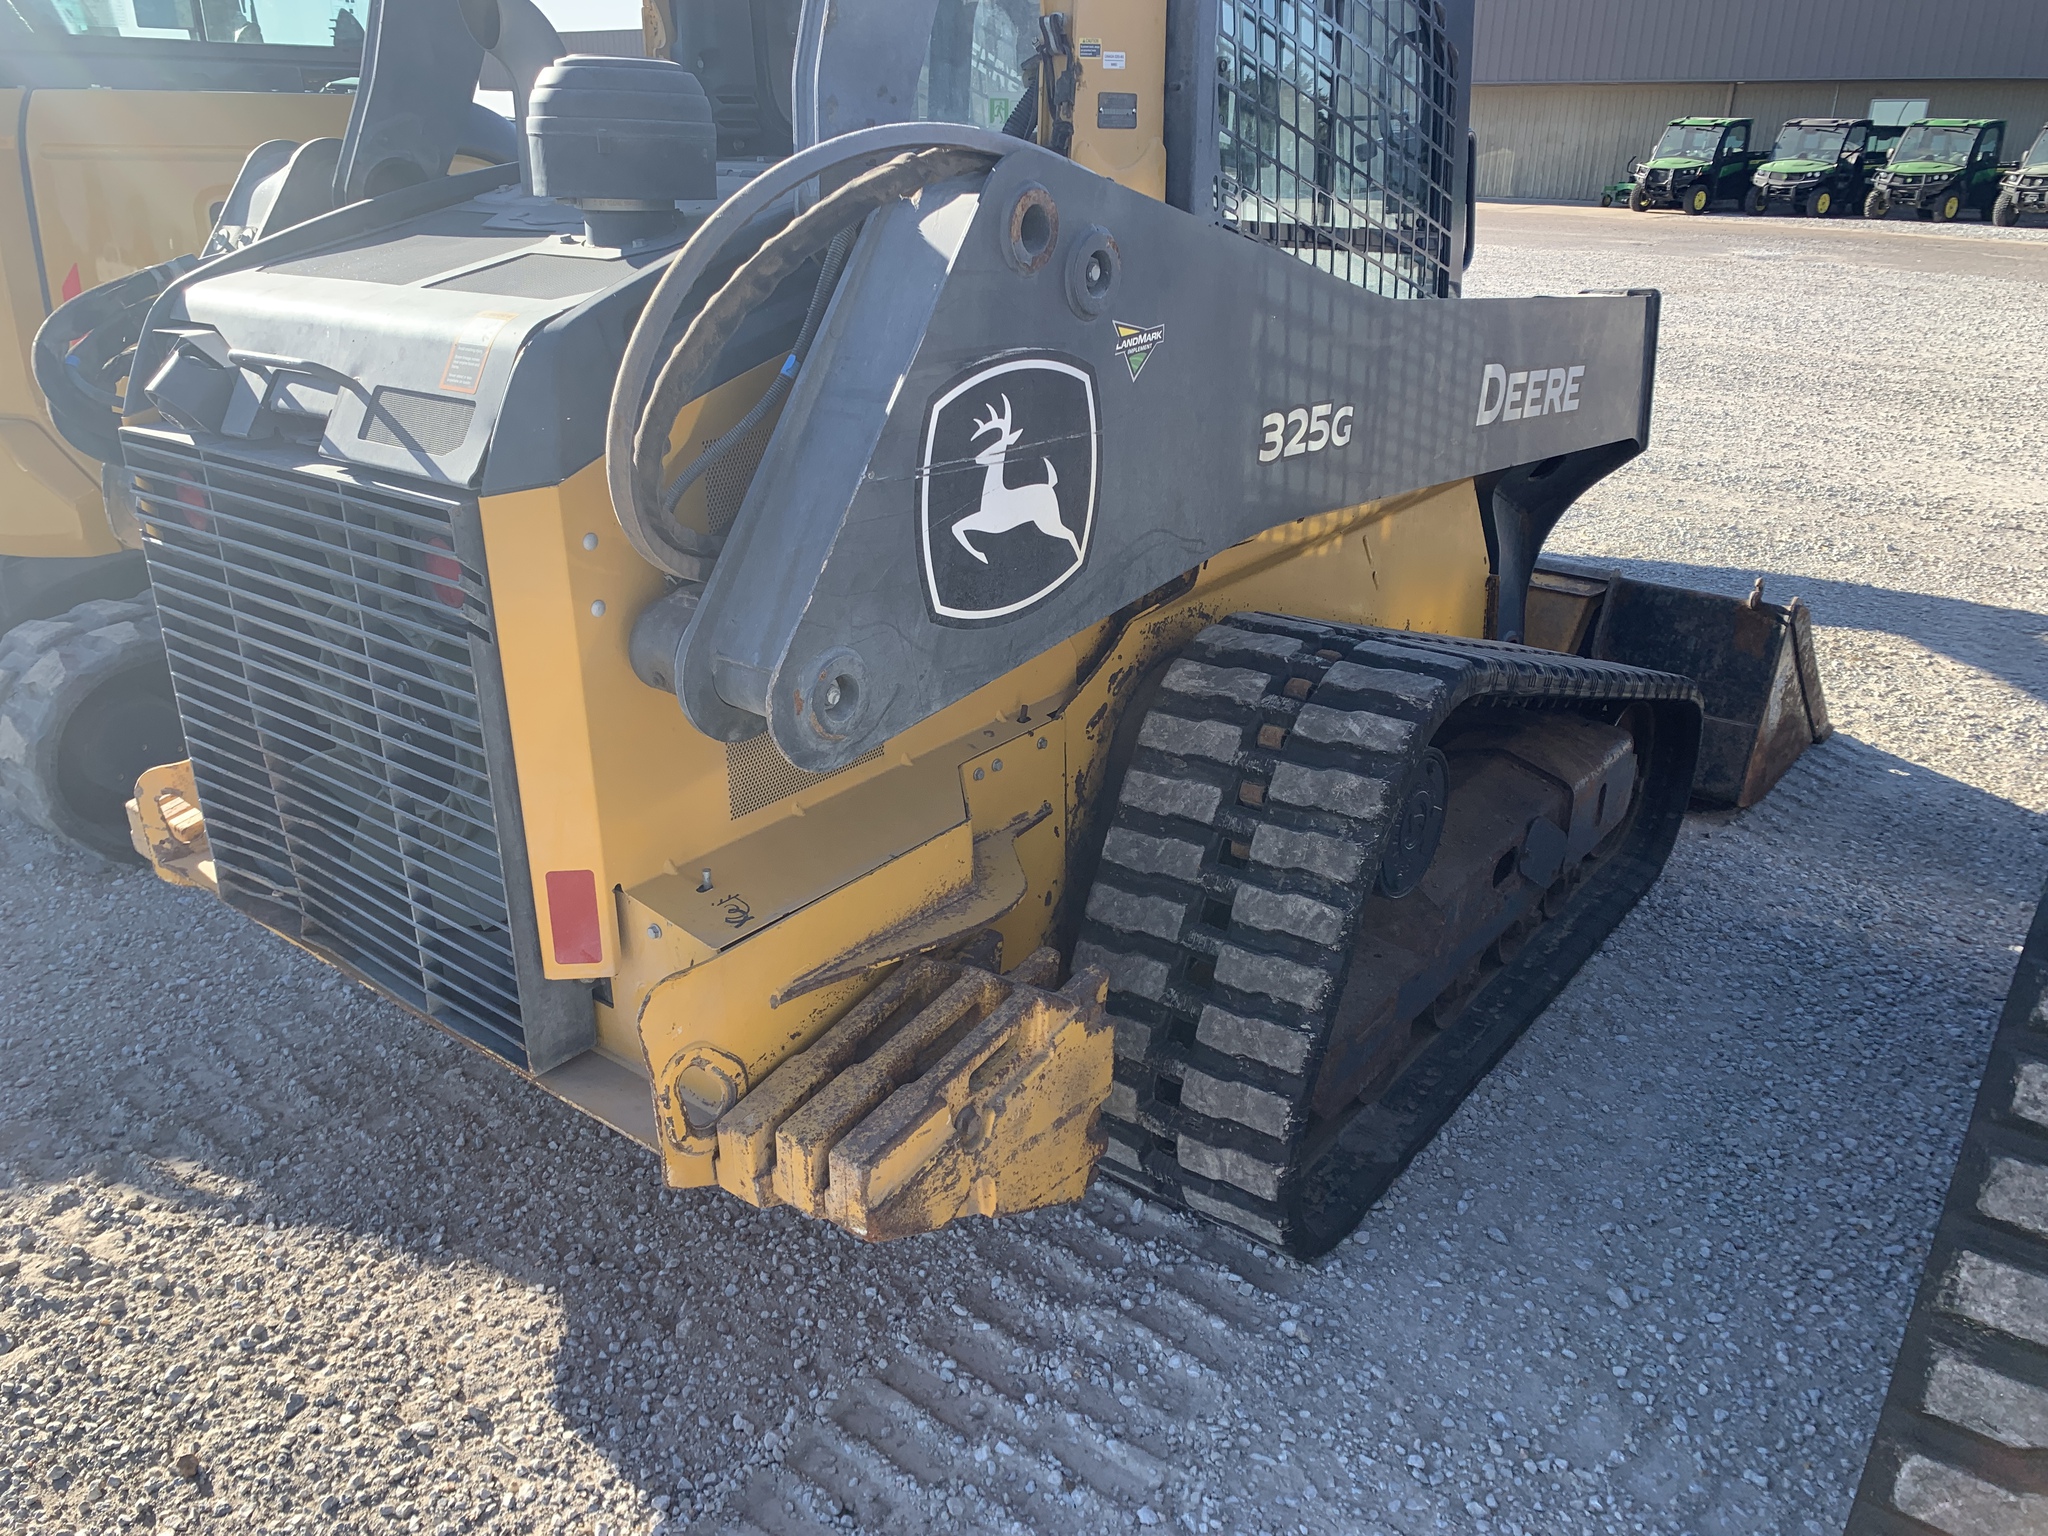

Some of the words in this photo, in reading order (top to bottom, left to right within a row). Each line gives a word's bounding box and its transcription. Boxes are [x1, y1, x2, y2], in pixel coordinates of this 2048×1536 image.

[1127, 343, 1153, 355] IMPLEMENT
[1476, 363, 1586, 427] DEERE
[1258, 403, 1354, 463] 325G
